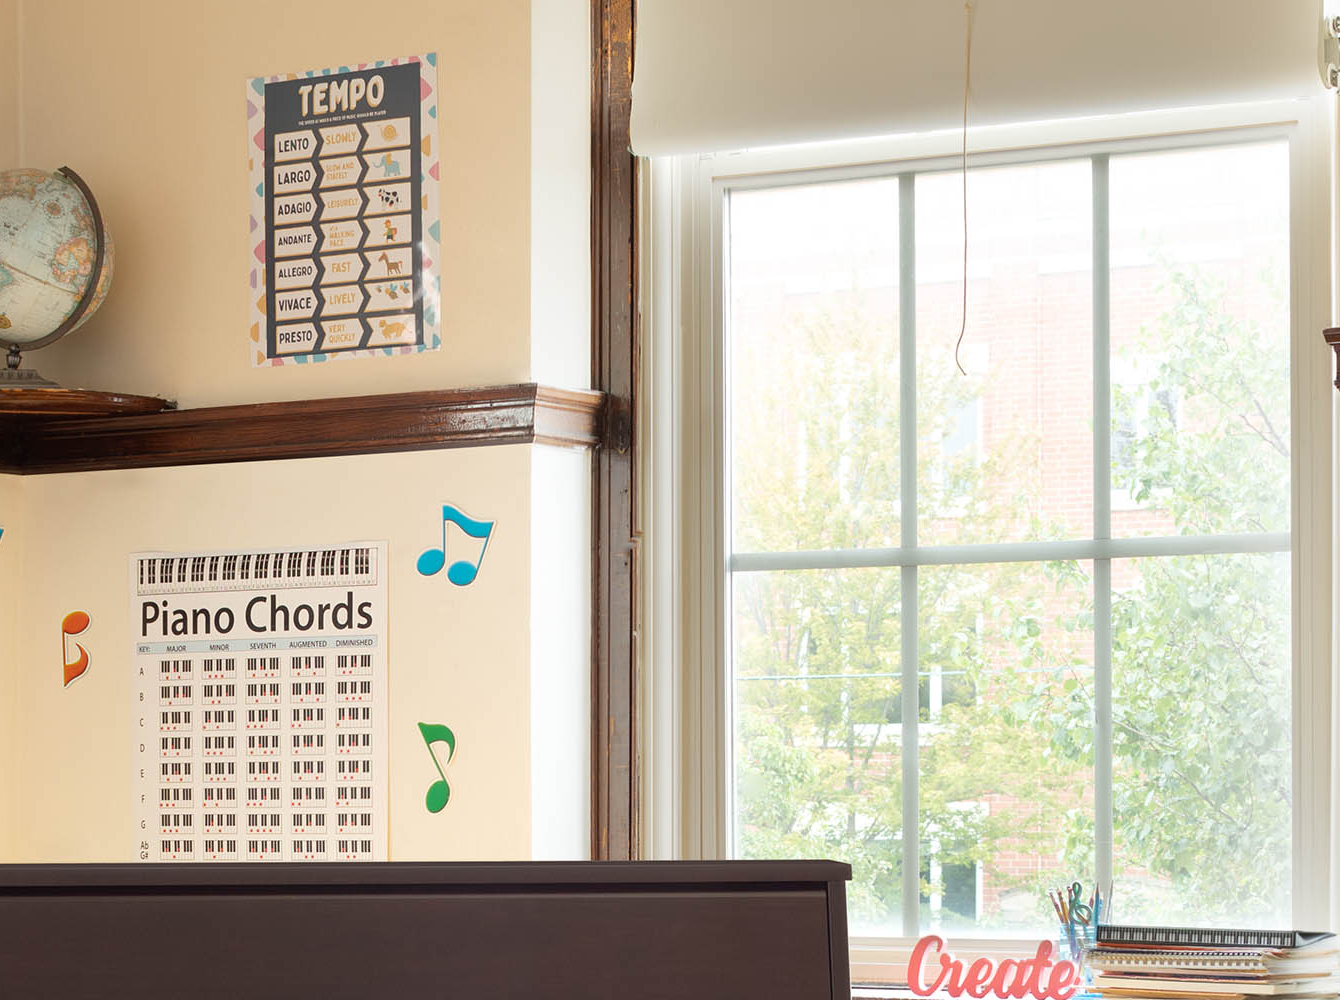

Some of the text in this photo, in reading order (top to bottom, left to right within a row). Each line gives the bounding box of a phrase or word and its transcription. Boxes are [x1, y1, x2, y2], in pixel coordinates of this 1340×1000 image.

[299, 75, 384, 117] TEMPO
[326, 131, 356, 144] SLOWLY
[279, 138, 309, 152] LENTO
[278, 171, 310, 185] LARGO
[278, 202, 311, 216] ADAGIO
[278, 234, 312, 246] ANDANTE
[278, 266, 312, 278] ALLEGRO
[332, 262, 351, 273] FAST
[279, 298, 312, 311] VIVACE
[330, 293, 356, 304] LIVELY
[280, 330, 312, 344] PRESTO
[142, 592, 373, 636] Piano Chords
[336, 639, 373, 647] DIMINISHED
[140, 693, 143, 701] B
[140, 718, 143, 727] C
[140, 744, 144, 752] D
[141, 769, 144, 778] E
[141, 820, 145, 829] G
[907, 934, 1082, 1000] Create
